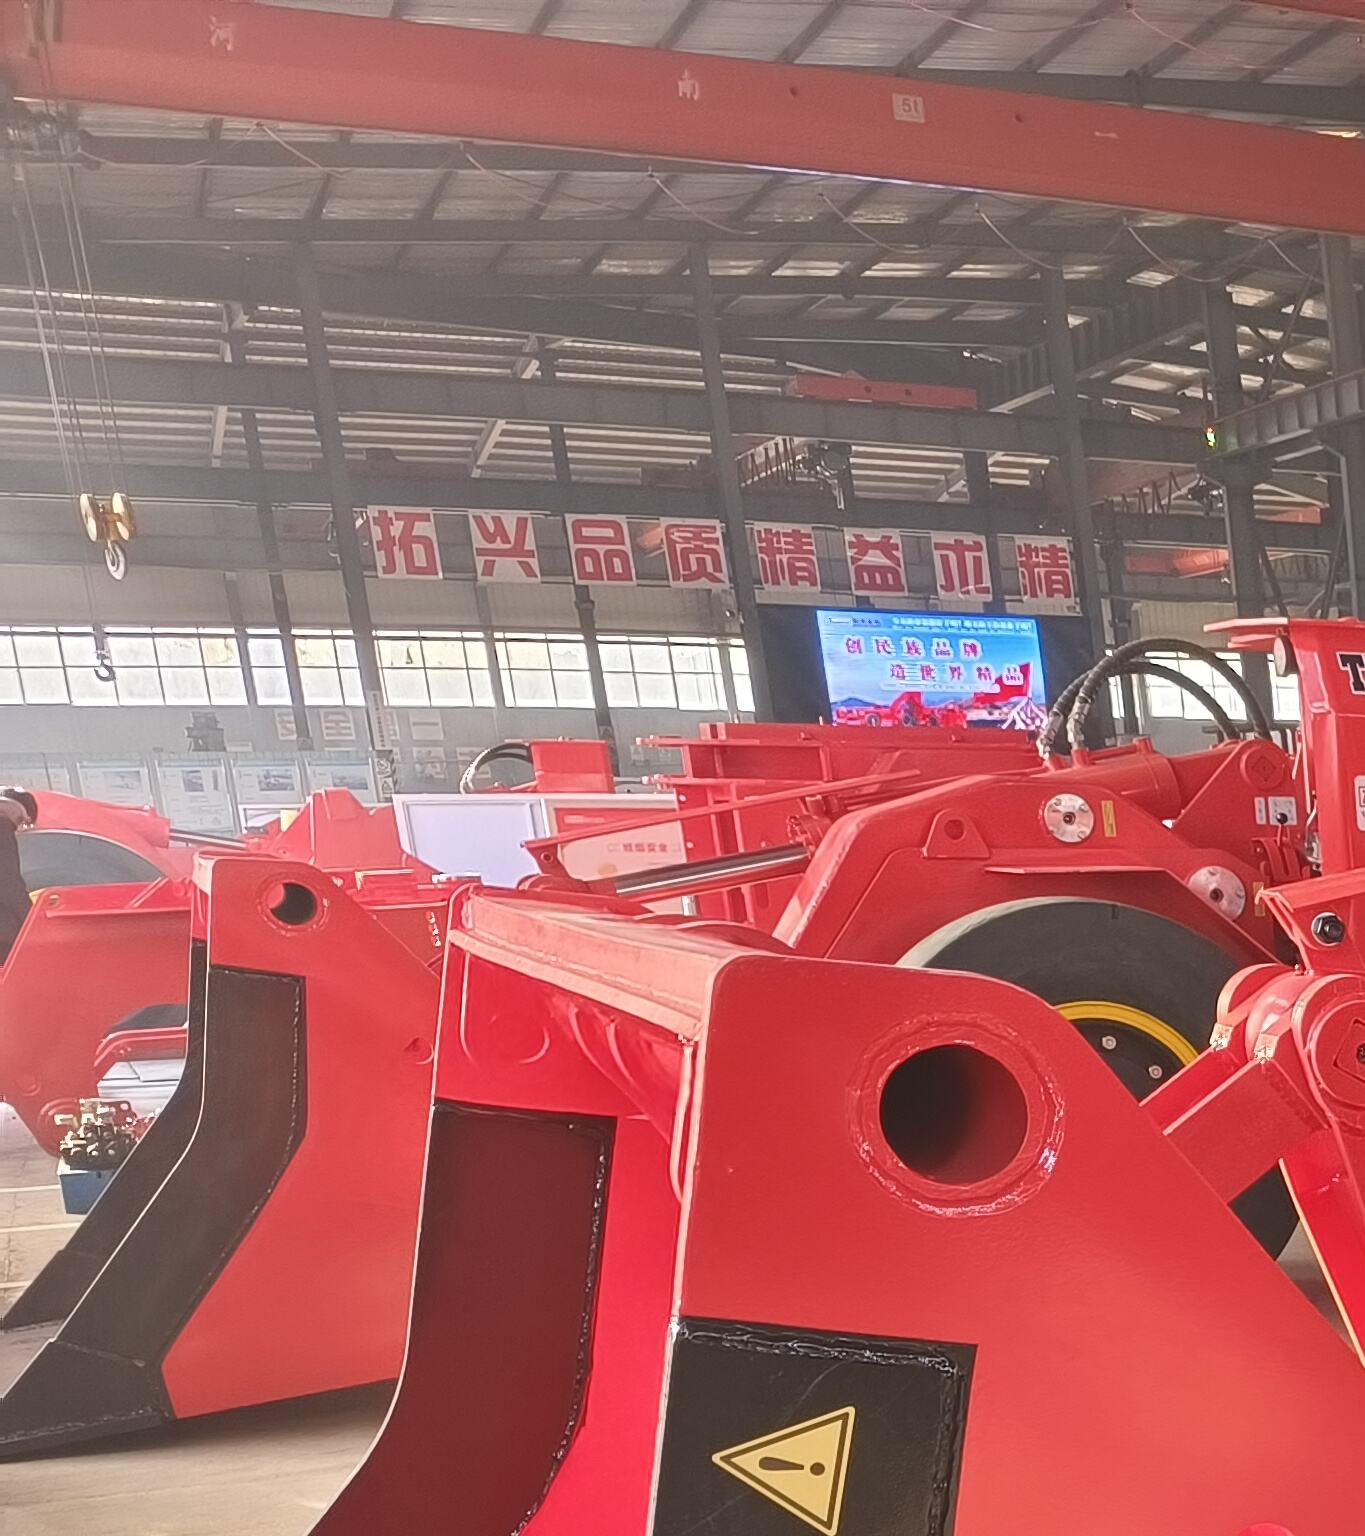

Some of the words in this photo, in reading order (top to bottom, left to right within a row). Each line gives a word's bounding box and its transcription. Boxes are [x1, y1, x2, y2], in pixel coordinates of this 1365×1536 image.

[372, 508, 1073, 600] 拓兴品质精益求精
[846, 637, 980, 660] 创民族品牌
